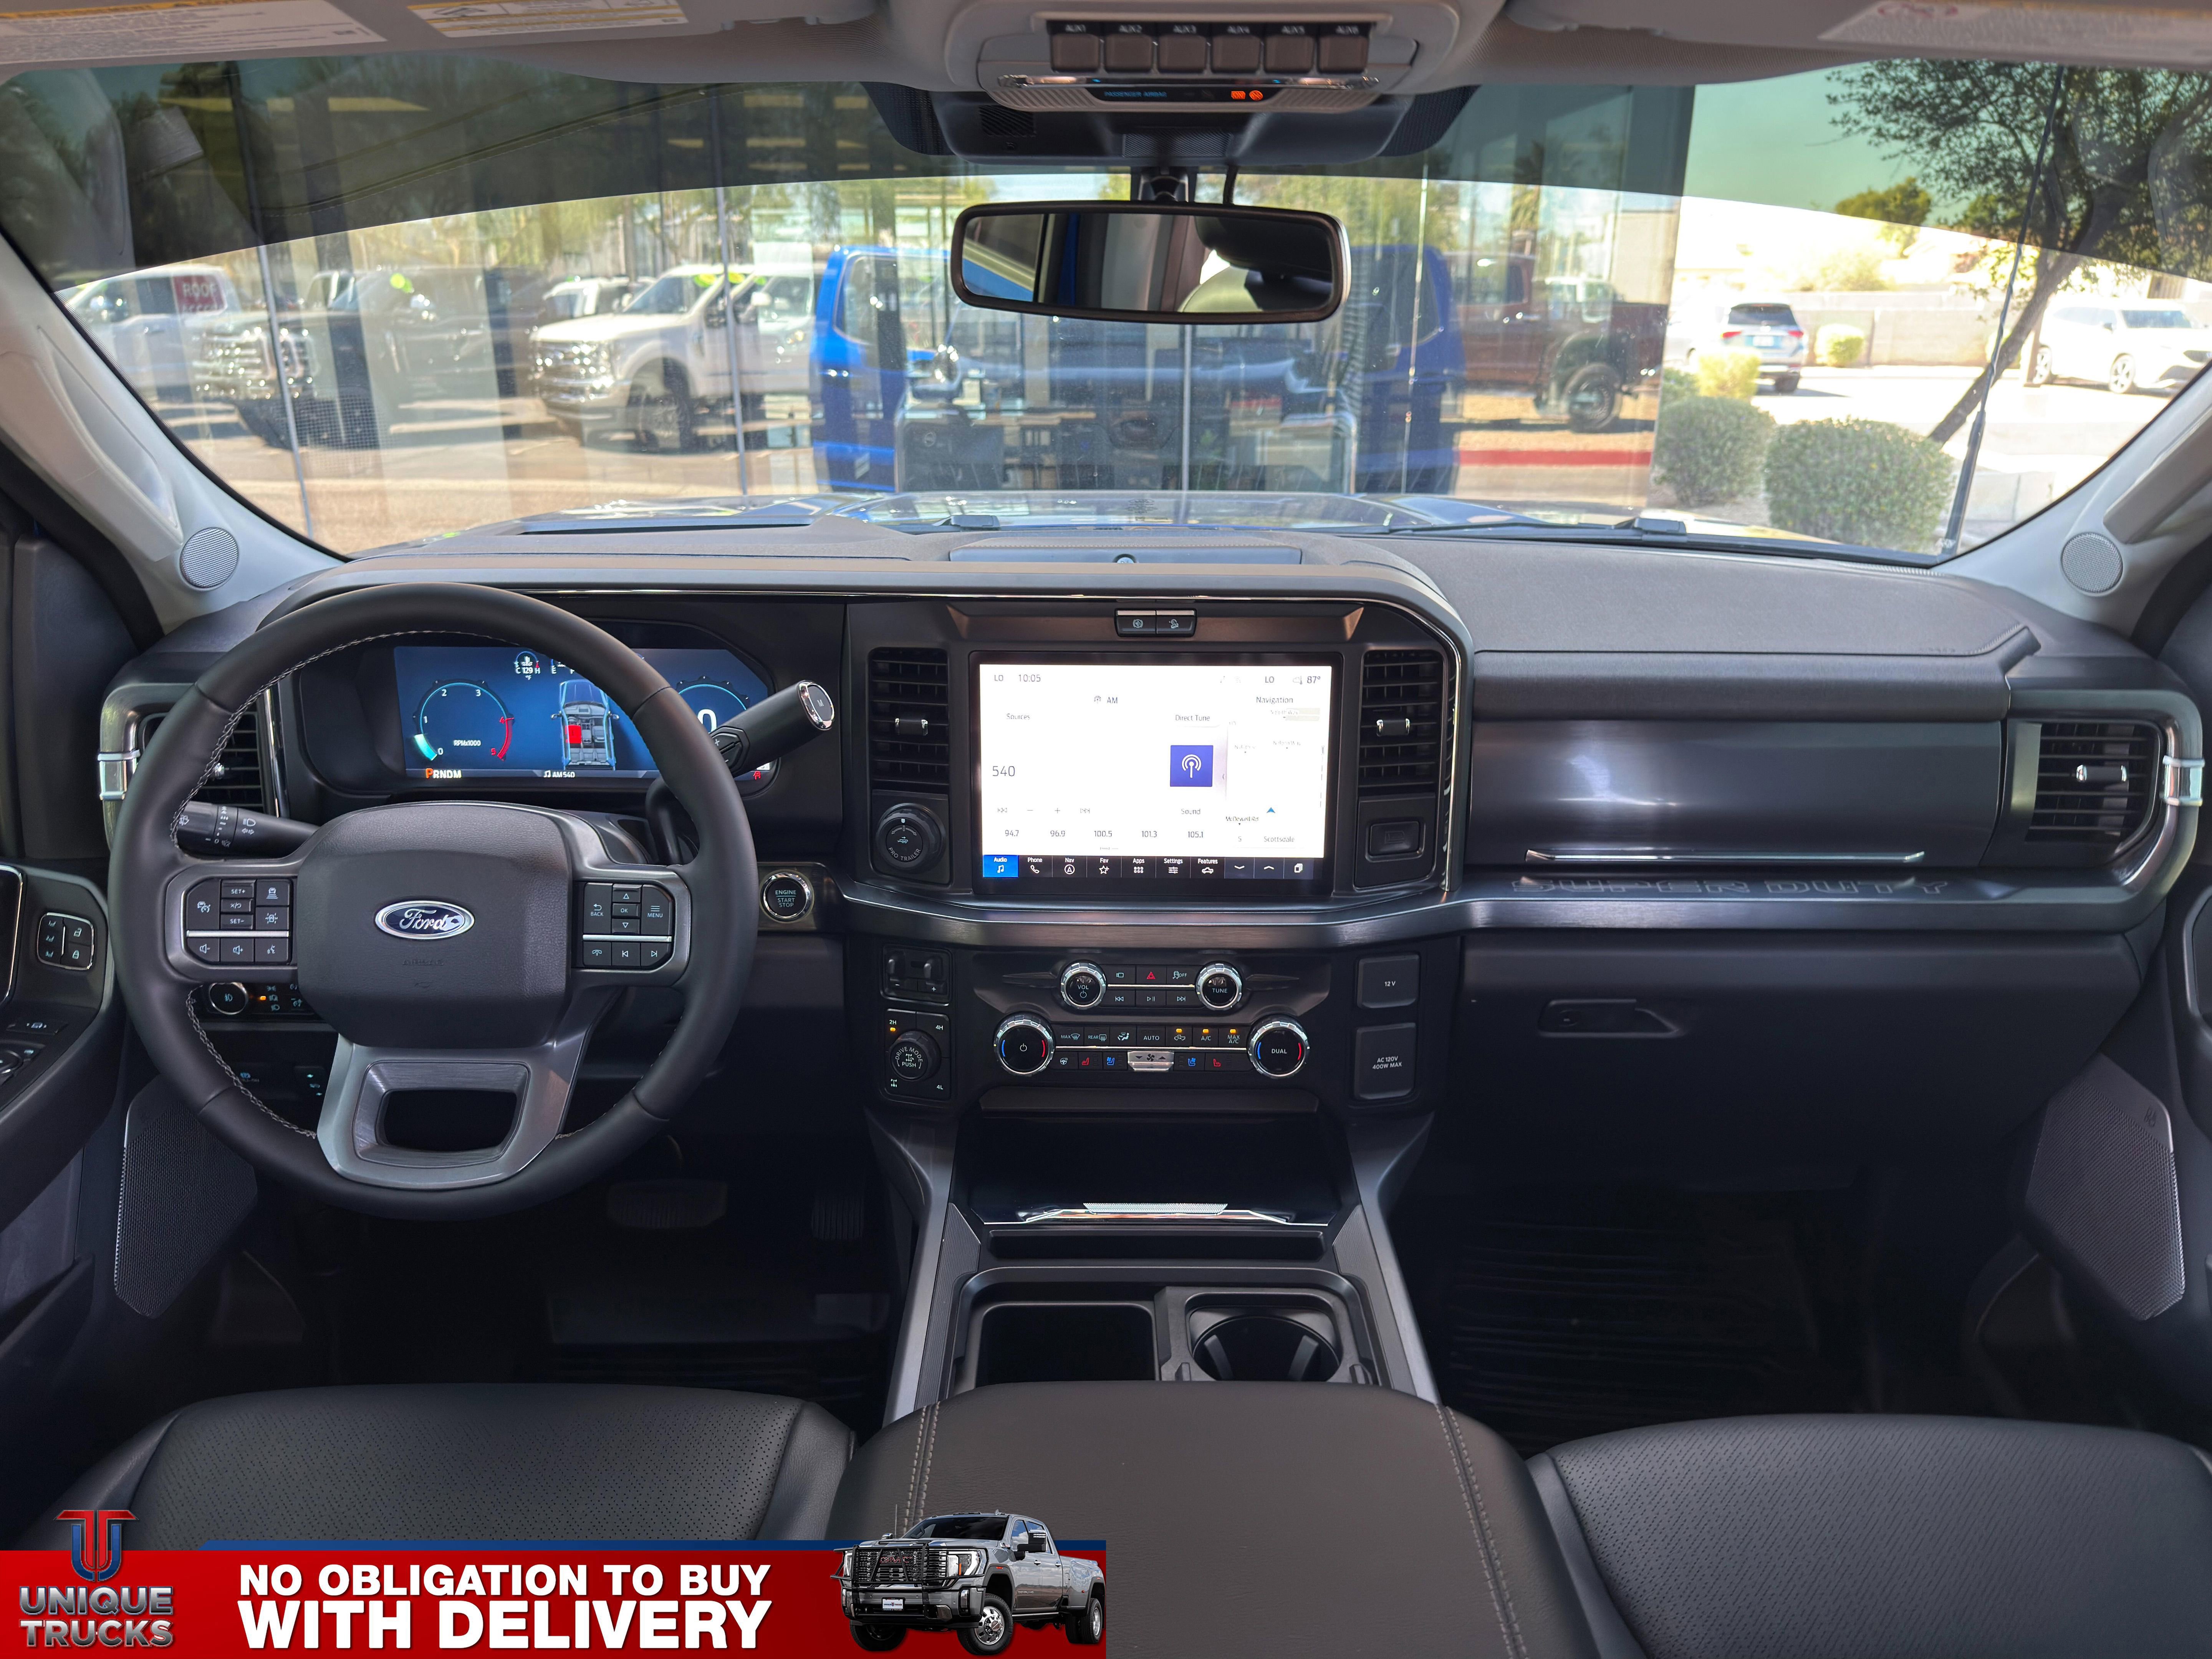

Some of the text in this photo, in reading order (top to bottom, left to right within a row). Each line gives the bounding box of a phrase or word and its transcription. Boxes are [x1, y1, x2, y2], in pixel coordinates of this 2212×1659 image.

[1018, 674, 1041, 682] 10:05
[1256, 696, 1294, 704] Navigation
[992, 765, 1015, 777] 540
[889, 847, 921, 861] PRO TRAILER
[399, 908, 449, 930] Ford
[895, 1046, 923, 1062] DRIVE MODE
